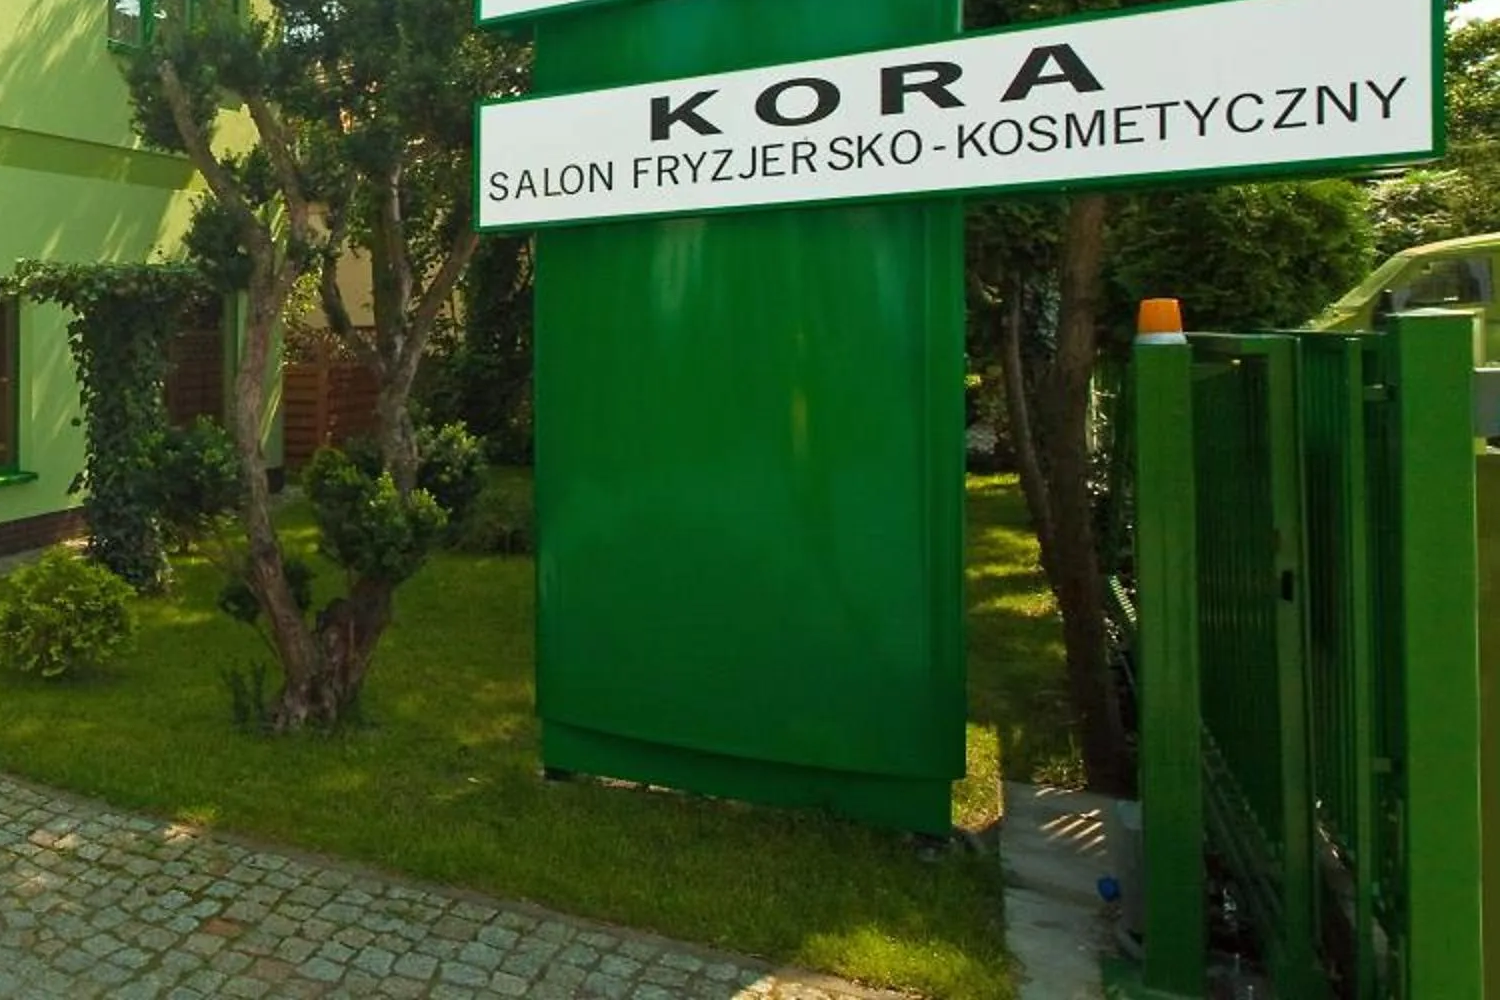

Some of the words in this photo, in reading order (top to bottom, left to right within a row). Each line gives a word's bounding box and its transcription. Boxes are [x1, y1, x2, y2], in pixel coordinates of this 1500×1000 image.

[489, 161, 614, 202] SALON
[633, 76, 1408, 189] FRYZJERSKO-KOSMETYCZNY
[651, 43, 1105, 141] KORA
